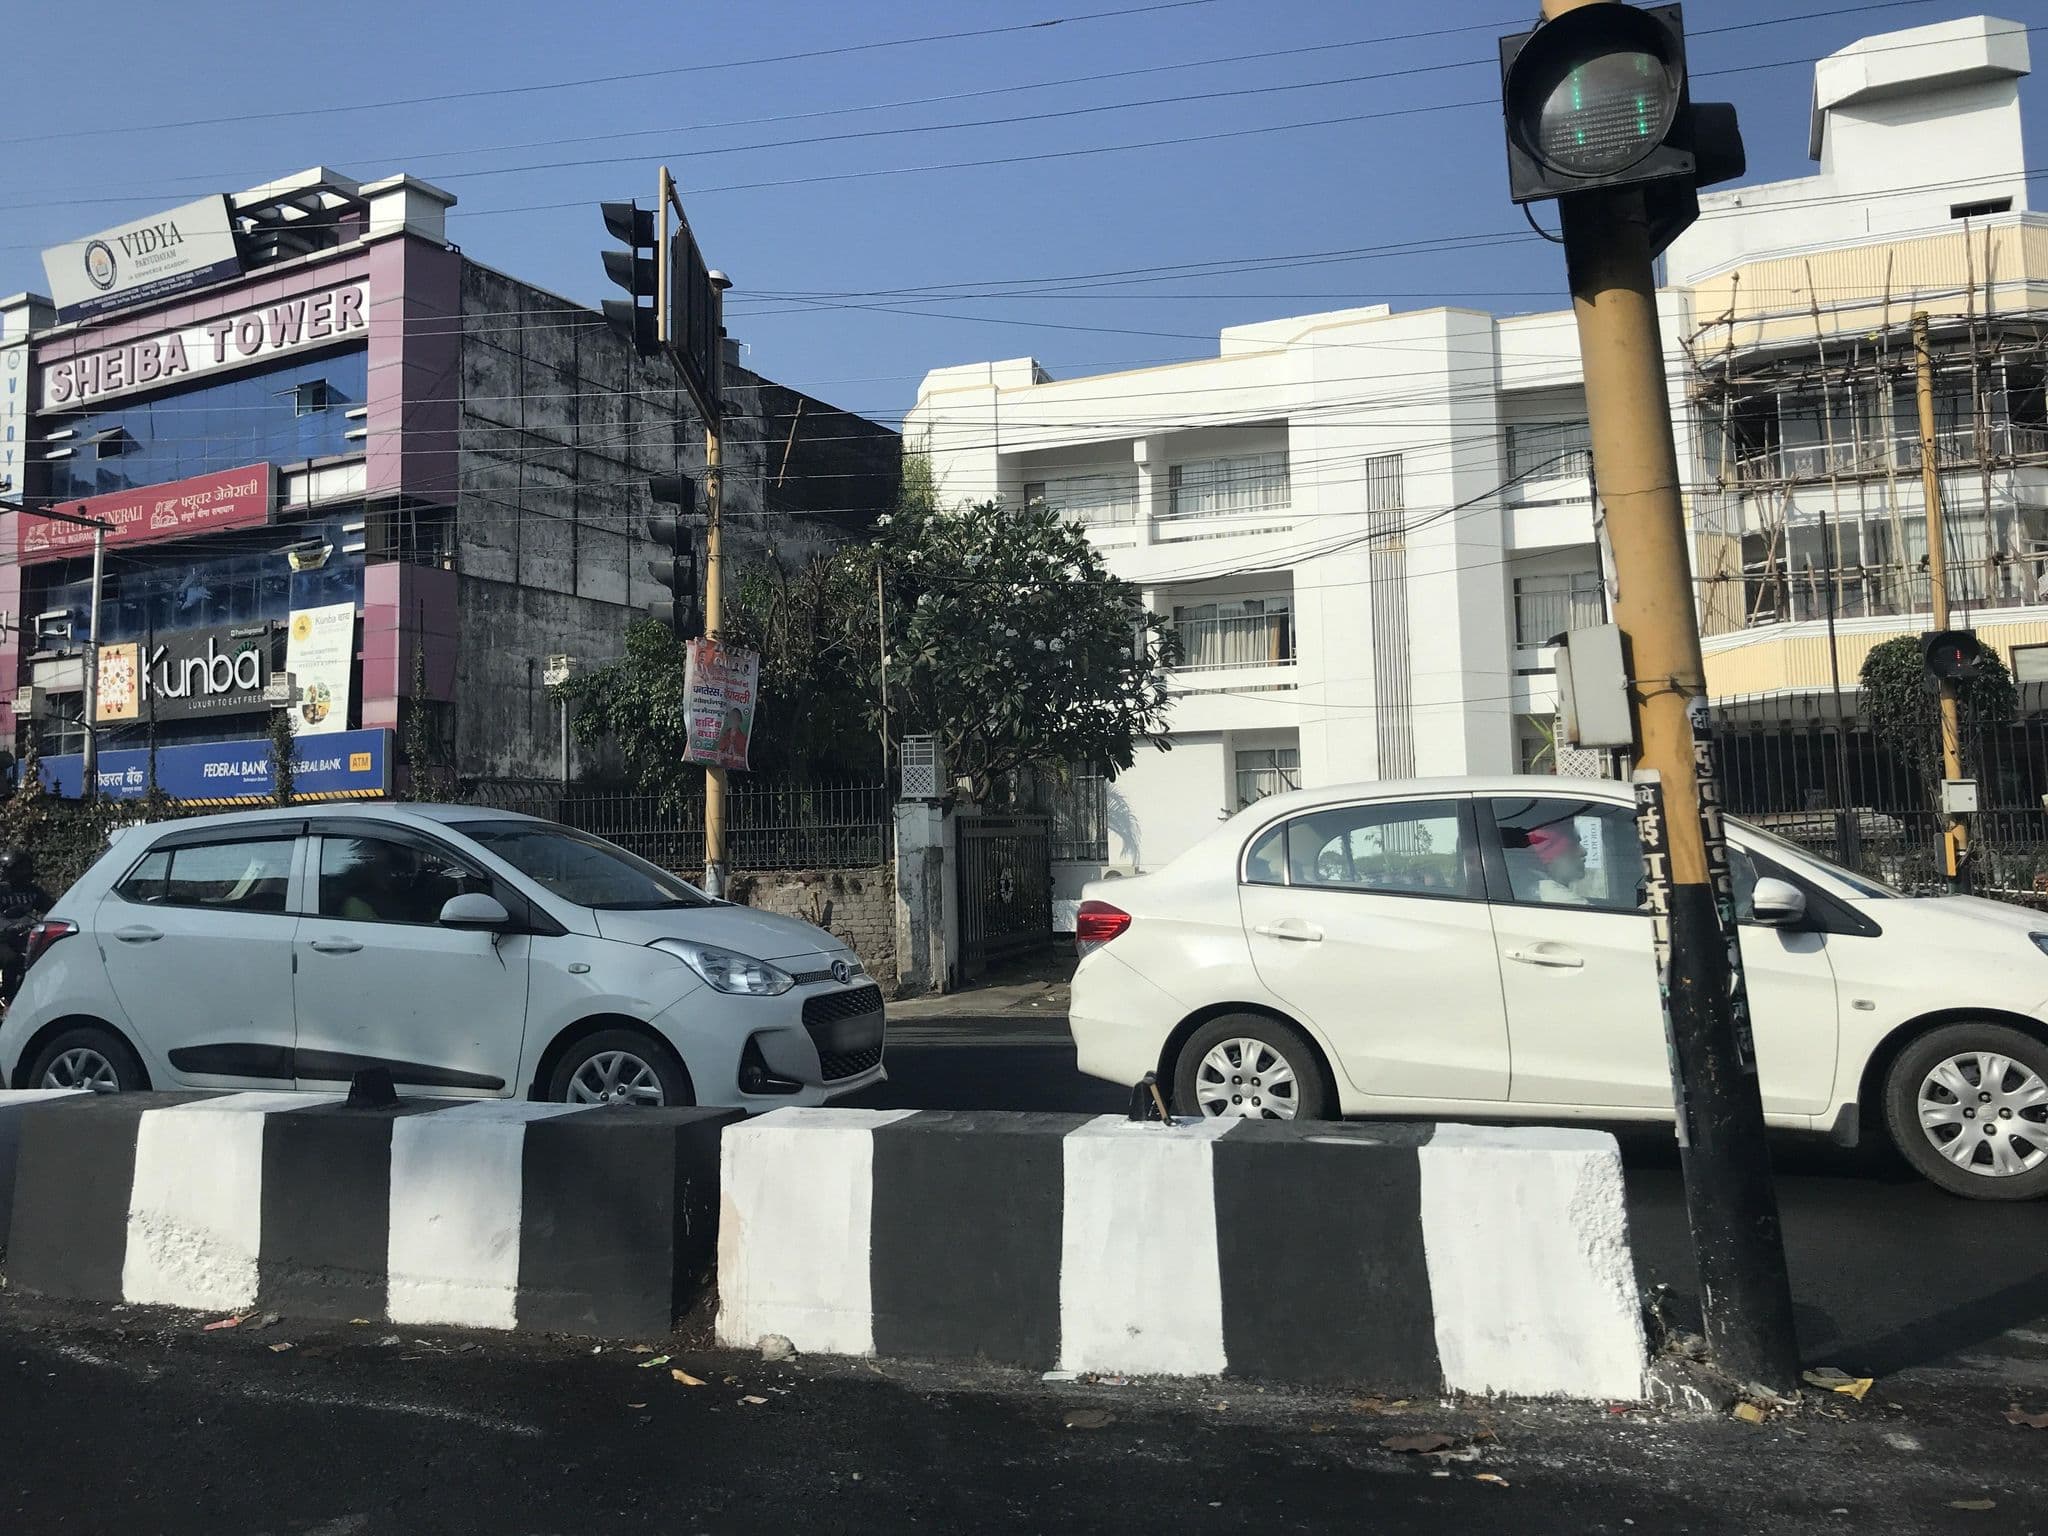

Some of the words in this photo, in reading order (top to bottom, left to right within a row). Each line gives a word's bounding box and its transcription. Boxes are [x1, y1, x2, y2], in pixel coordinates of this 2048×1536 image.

[118, 220, 184, 258] VIDYA
[50, 333, 189, 402] SHEIBA
[206, 285, 365, 364] TOWER
[141, 637, 260, 701] Kunba
[188, 699, 216, 710] LUXURY
[218, 698, 227, 707] TO
[228, 696, 242, 706] EAT
[203, 761, 240, 778] FEDERAL
[241, 759, 268, 776] BANK
[320, 758, 342, 771] BANK
[351, 756, 369, 769] ATM
